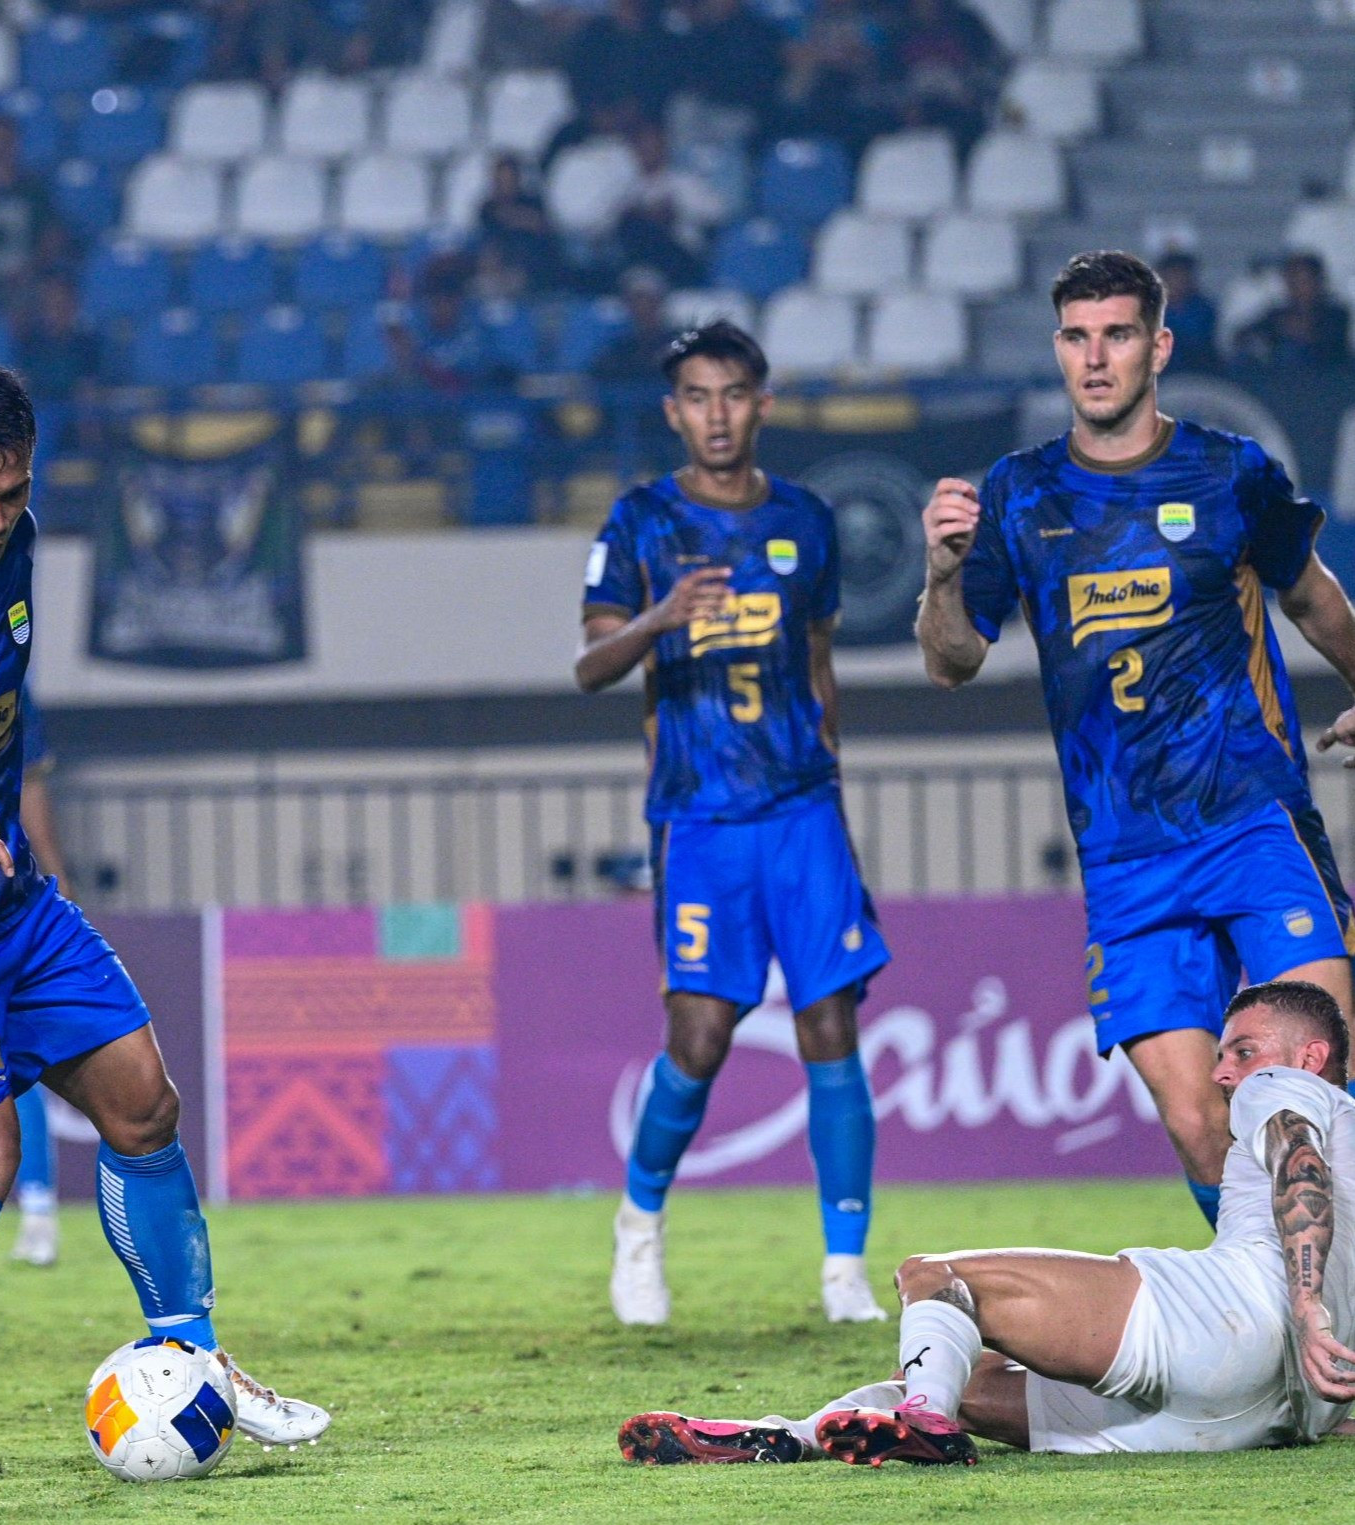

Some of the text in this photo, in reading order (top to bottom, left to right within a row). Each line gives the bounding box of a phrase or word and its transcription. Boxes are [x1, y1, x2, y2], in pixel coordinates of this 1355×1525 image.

[727, 663, 764, 724] 5
[1107, 648, 1146, 713] 2
[675, 902, 712, 962] 5
[1086, 942, 1110, 1005] 2
